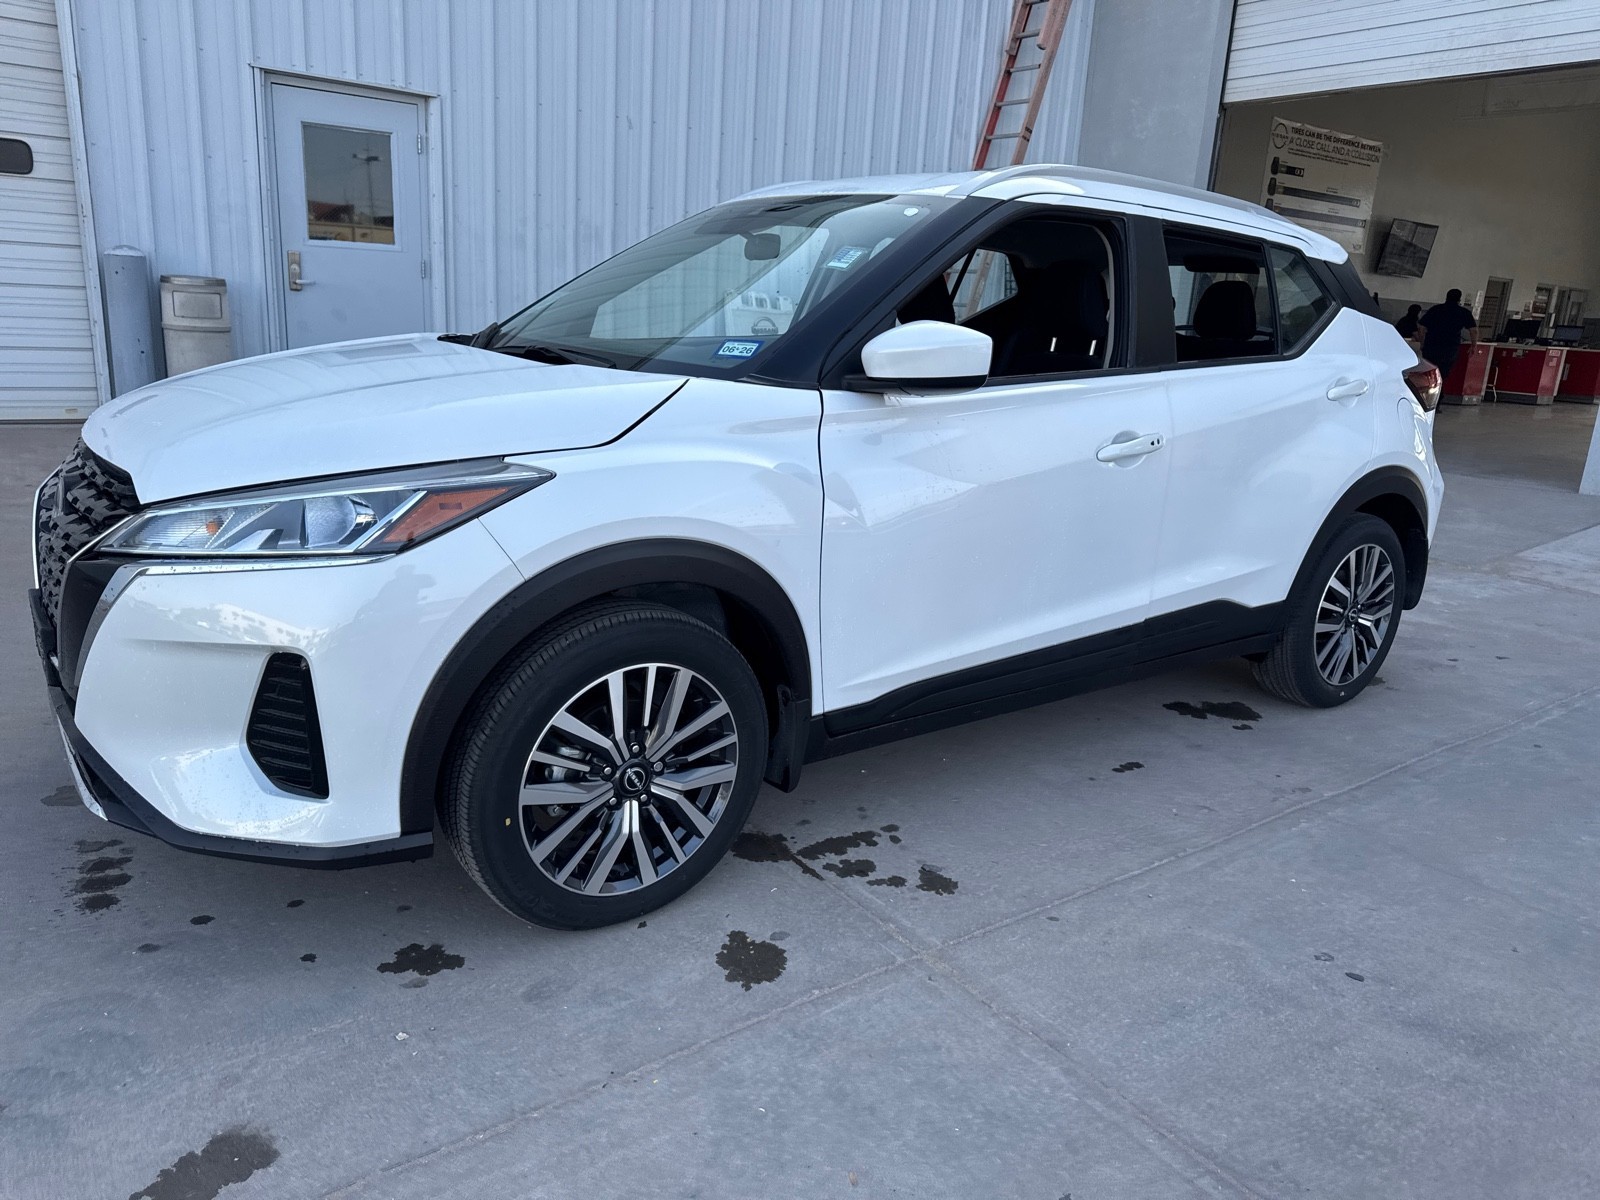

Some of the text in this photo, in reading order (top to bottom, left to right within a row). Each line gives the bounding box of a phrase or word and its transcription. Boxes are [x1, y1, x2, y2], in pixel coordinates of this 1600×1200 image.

[1291, 127, 1304, 135] TIRES
[1305, 130, 1316, 138] CAN
[1324, 134, 1333, 142] THE
[1333, 137, 1360, 148] DIFFERENCE
[1361, 144, 1381, 153] BETWEEN
[1295, 137, 1315, 150] CLOSE
[1316, 142, 1331, 153] CALL
[1331, 145, 1345, 155] AND
[1351, 150, 1380, 163] COLLISION
